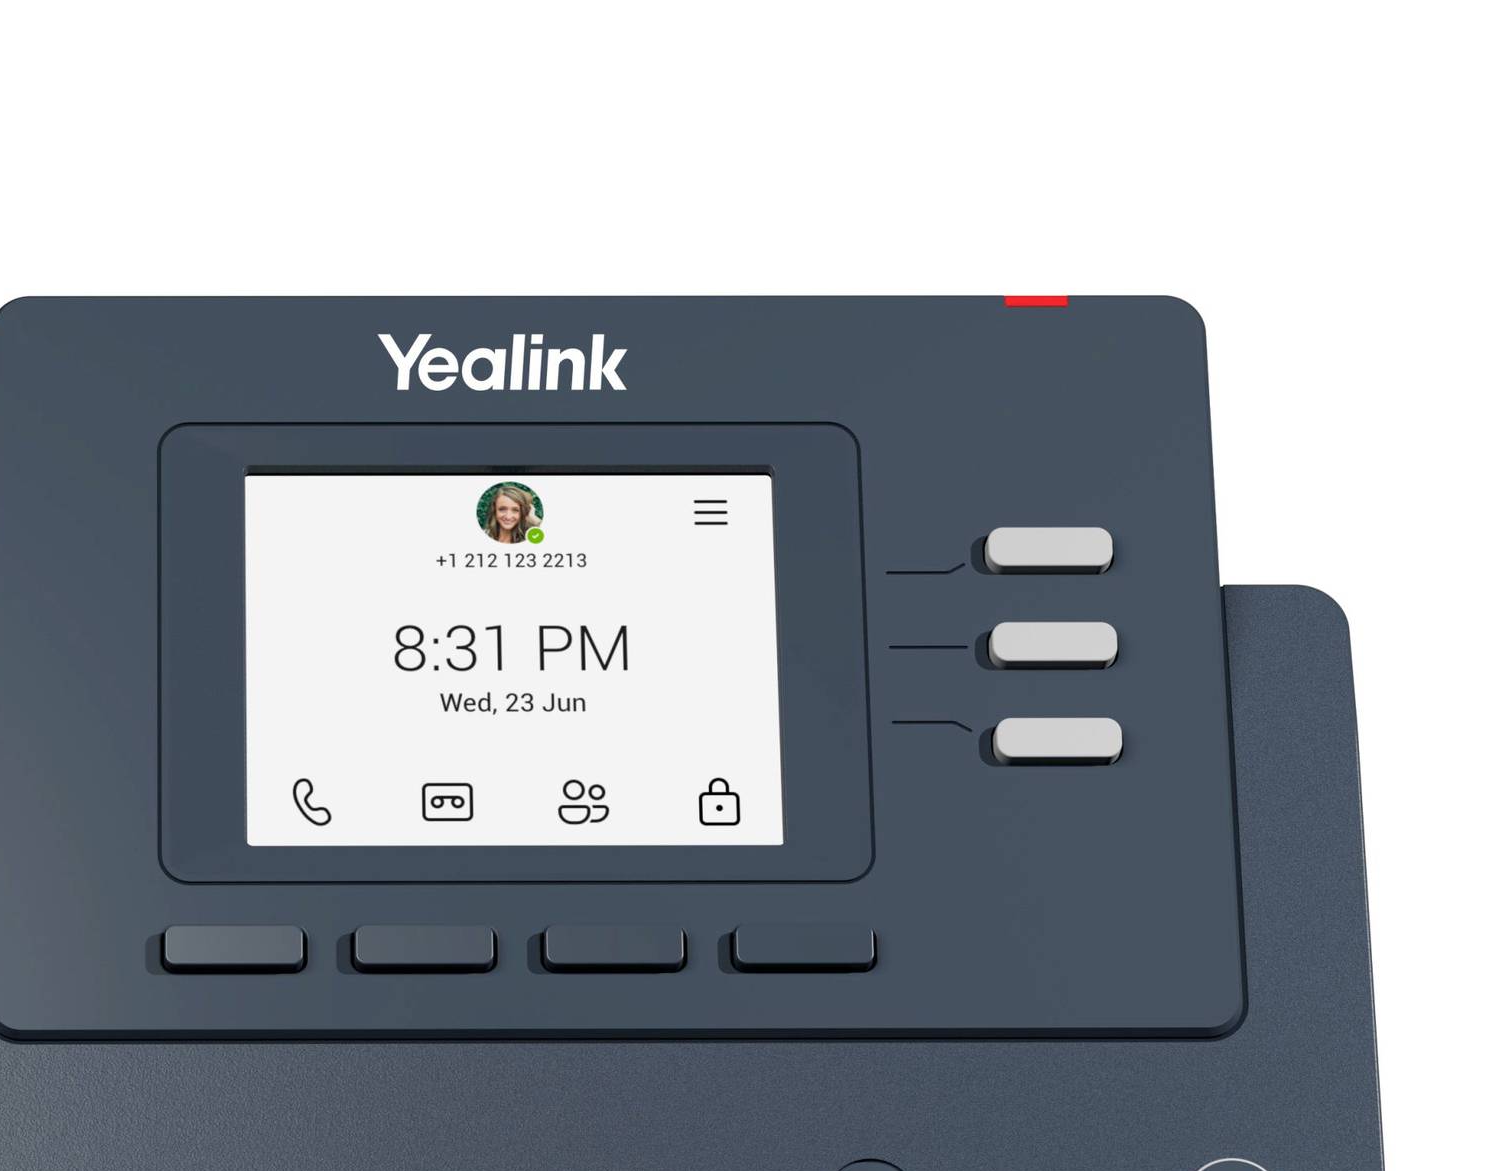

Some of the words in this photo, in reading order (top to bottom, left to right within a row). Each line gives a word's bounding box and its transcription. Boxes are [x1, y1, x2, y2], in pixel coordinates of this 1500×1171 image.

[377, 333, 628, 392] Yealink
[436, 553, 456, 568] +1
[465, 553, 498, 568] 212
[504, 553, 537, 568] 123
[542, 553, 587, 568] 2213
[394, 624, 503, 672] 8:31
[538, 625, 629, 671] PM
[440, 691, 497, 715] Wed,
[505, 692, 534, 713] 23
[542, 693, 586, 712] Jun
